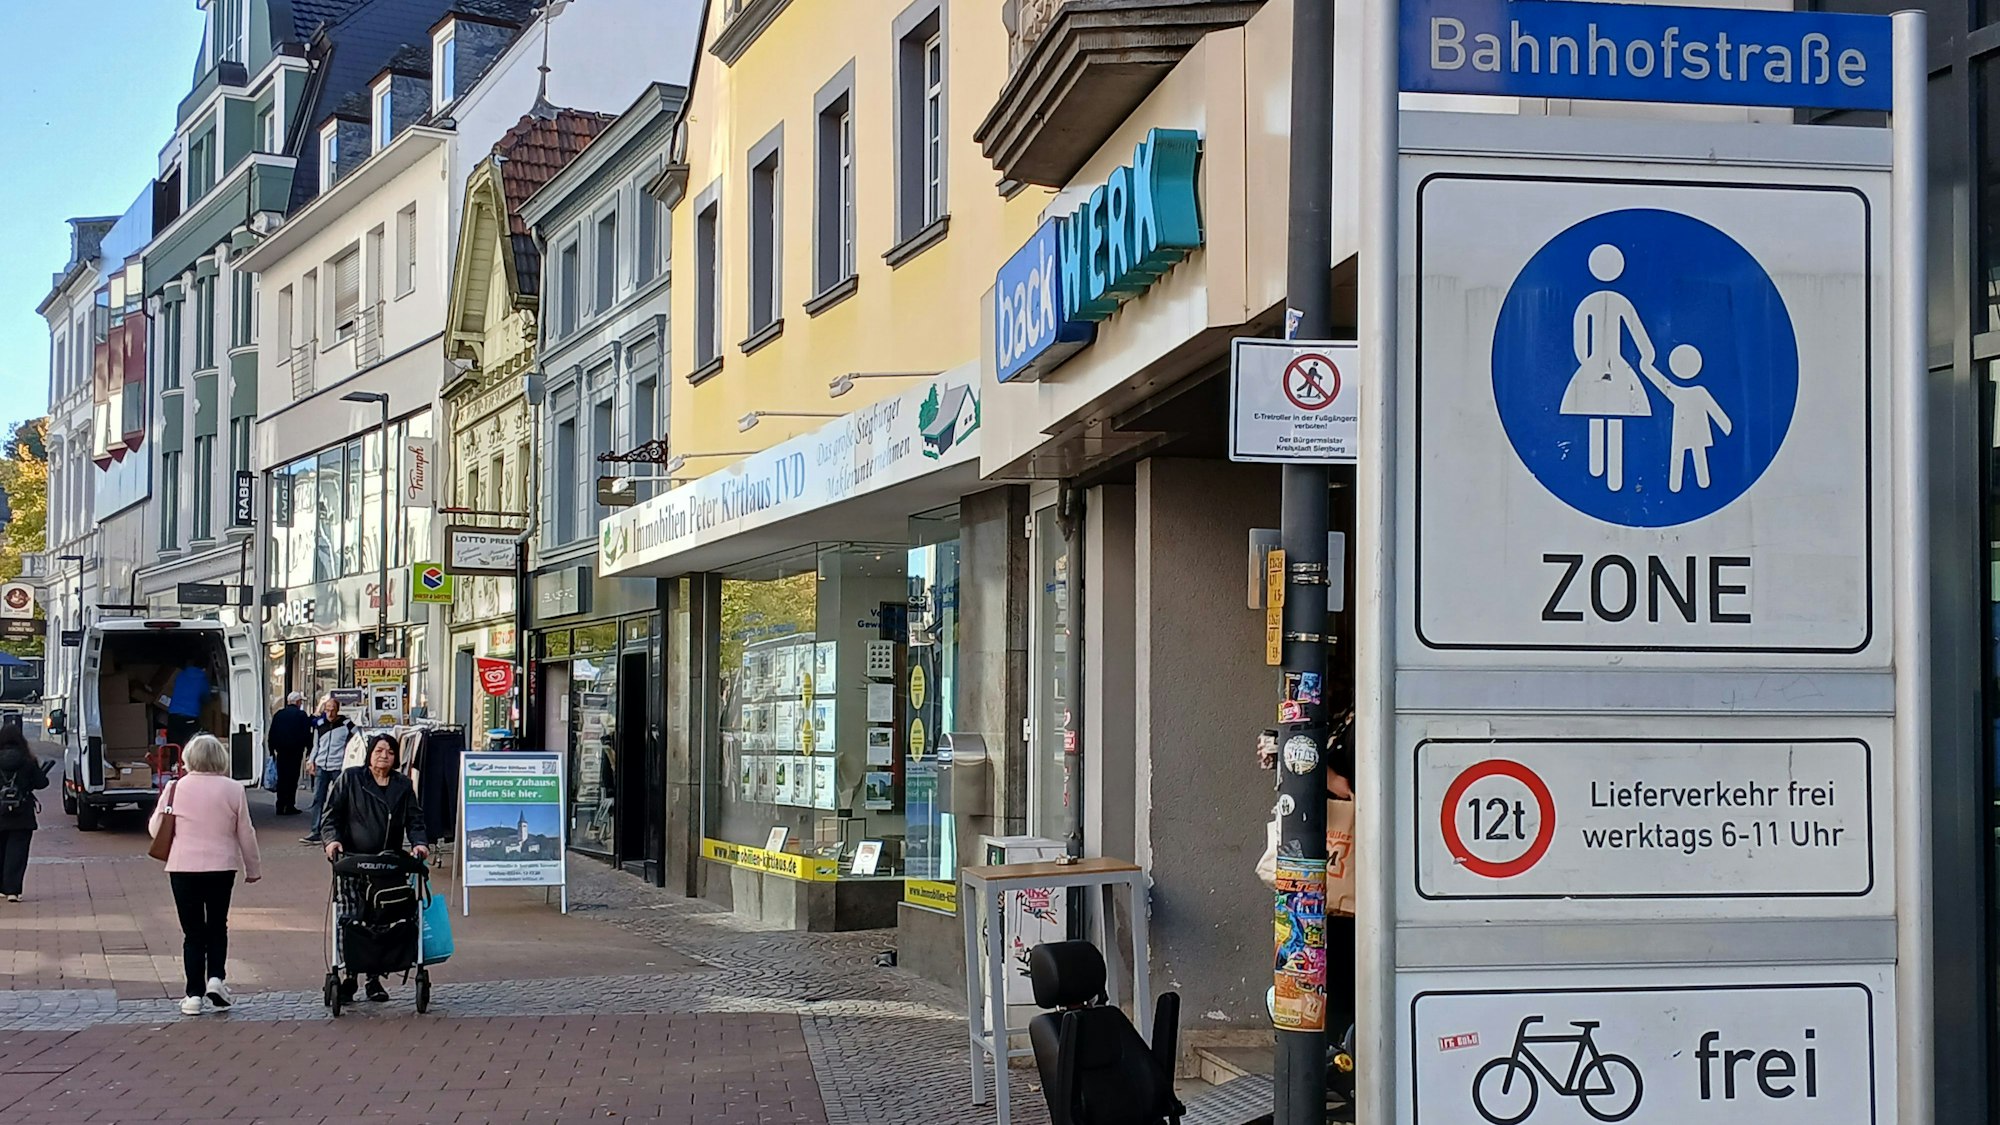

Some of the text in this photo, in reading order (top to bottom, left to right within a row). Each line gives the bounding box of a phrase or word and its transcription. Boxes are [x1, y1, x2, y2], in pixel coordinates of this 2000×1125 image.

[1430, 17, 1867, 87] Bahnhofstraße
[1000, 128, 1158, 370] back WERK
[817, 442, 832, 466] Das
[855, 397, 902, 445] Siegburger
[1293, 436, 1343, 444] Bürgermeister
[408, 445, 430, 500] Triumph
[826, 435, 911, 502] Maklerunternehmen
[238, 476, 250, 520] RABE
[632, 451, 806, 554] Immobilien Peter Kittlaus IVD
[456, 535, 487, 544] LOTTO
[1541, 553, 1751, 624] ZONE
[277, 599, 309, 627] RABE
[355, 668, 385, 676] STREET
[468, 778, 556, 787] Ihr neues Zuhause
[468, 789, 543, 798] finden Sie hier.
[1590, 780, 1836, 808] Lieferverkehr frei
[1468, 798, 1526, 841] 12t
[1583, 821, 1845, 855] werktags 6-11 Uhr
[1695, 1028, 1817, 1100] frei
